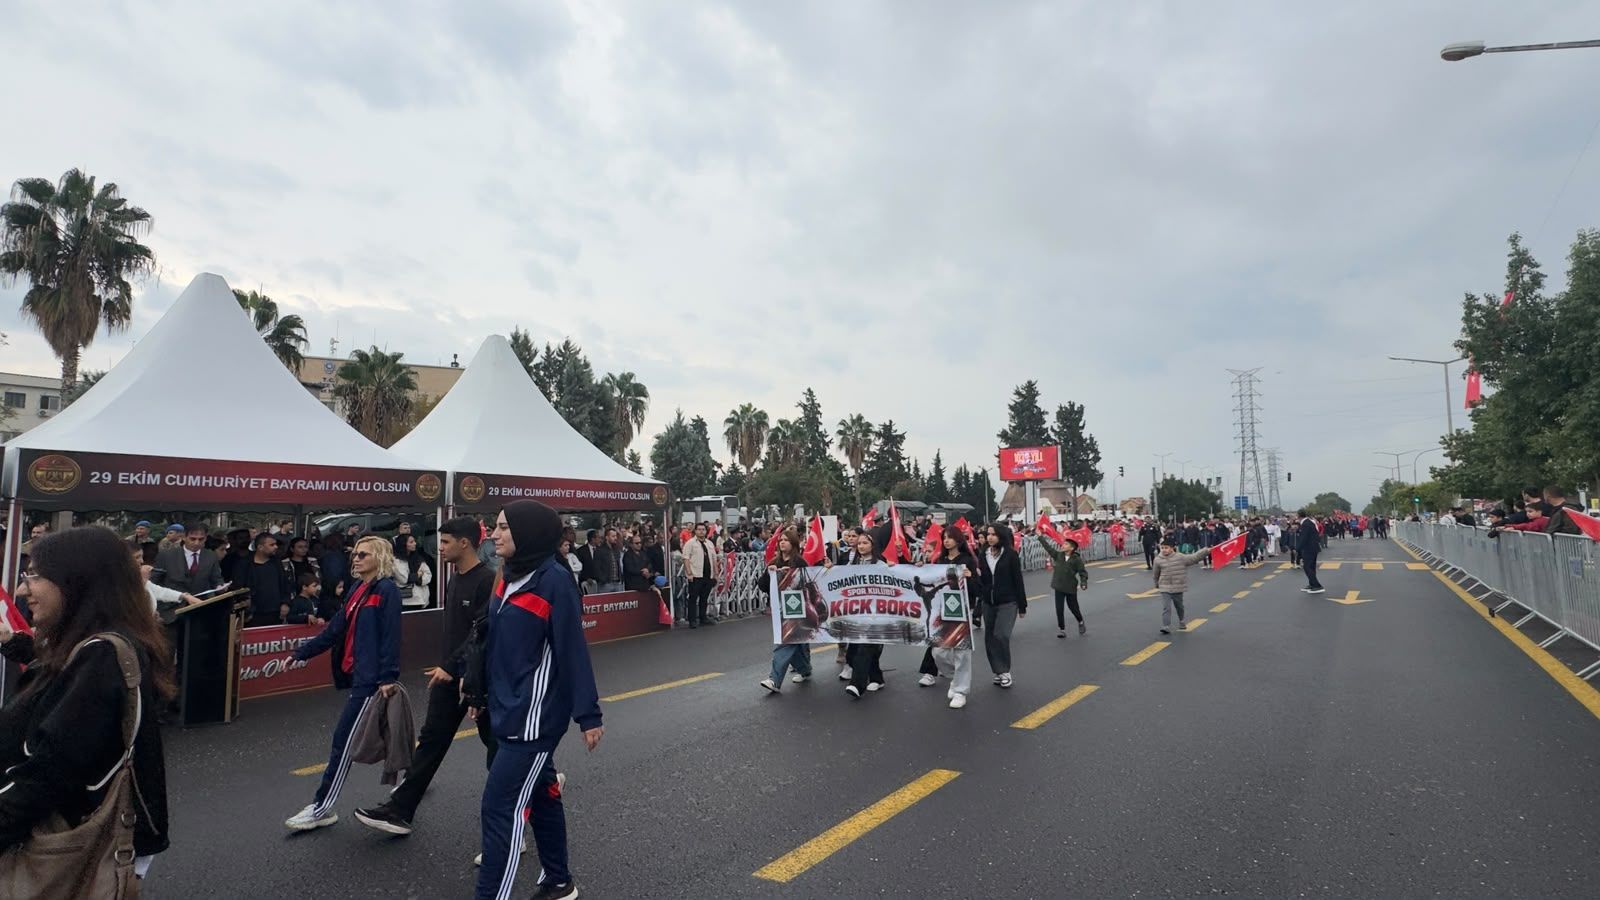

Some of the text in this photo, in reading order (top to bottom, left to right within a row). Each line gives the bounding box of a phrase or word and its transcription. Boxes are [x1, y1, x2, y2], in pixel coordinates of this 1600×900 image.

[90, 470, 410, 492] 29 EKİM CUMHURİYET BAYRAMI KUTLU OLSUN
[488, 486, 650, 500] 29 EKİM CUMHURİYET BAYRAMI KUTLU OLSUN
[828, 574, 913, 591] OSMANİYE BELEDİYESİ
[847, 587, 866, 597] SPOR
[603, 600, 638, 612] BAYRAMI
[876, 599, 922, 618] BOKS
